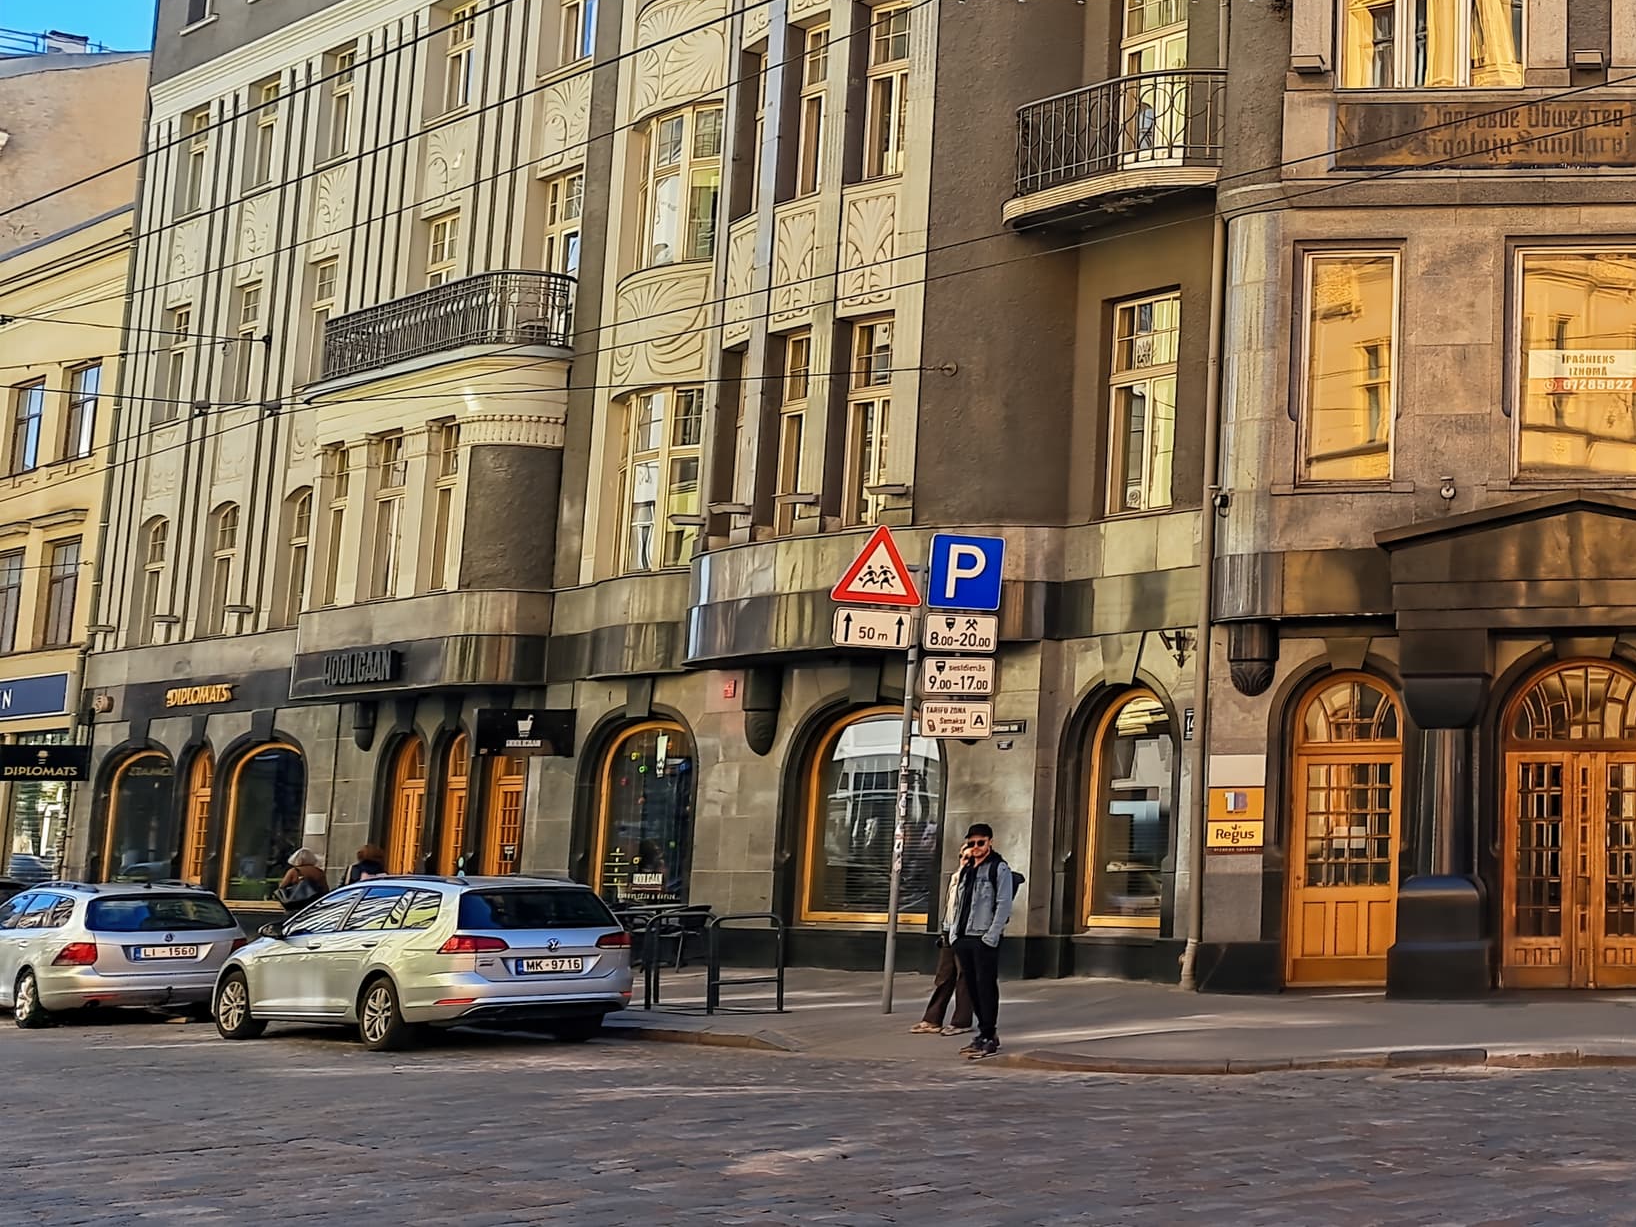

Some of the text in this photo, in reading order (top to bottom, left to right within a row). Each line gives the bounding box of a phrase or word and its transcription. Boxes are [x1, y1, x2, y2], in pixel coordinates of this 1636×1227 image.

[945, 543, 987, 599] P
[858, 626, 888, 641] 50 m
[930, 631, 991, 648] 8.00-20.00
[928, 675, 988, 690] 9.00-17.00
[166, 683, 234, 708] DIPLOMATS
[973, 715, 984, 726] A
[4, 766, 78, 776] DIPLOMATS
[1215, 828, 1255, 844] Regus
[526, 959, 580, 971] MK-9716
